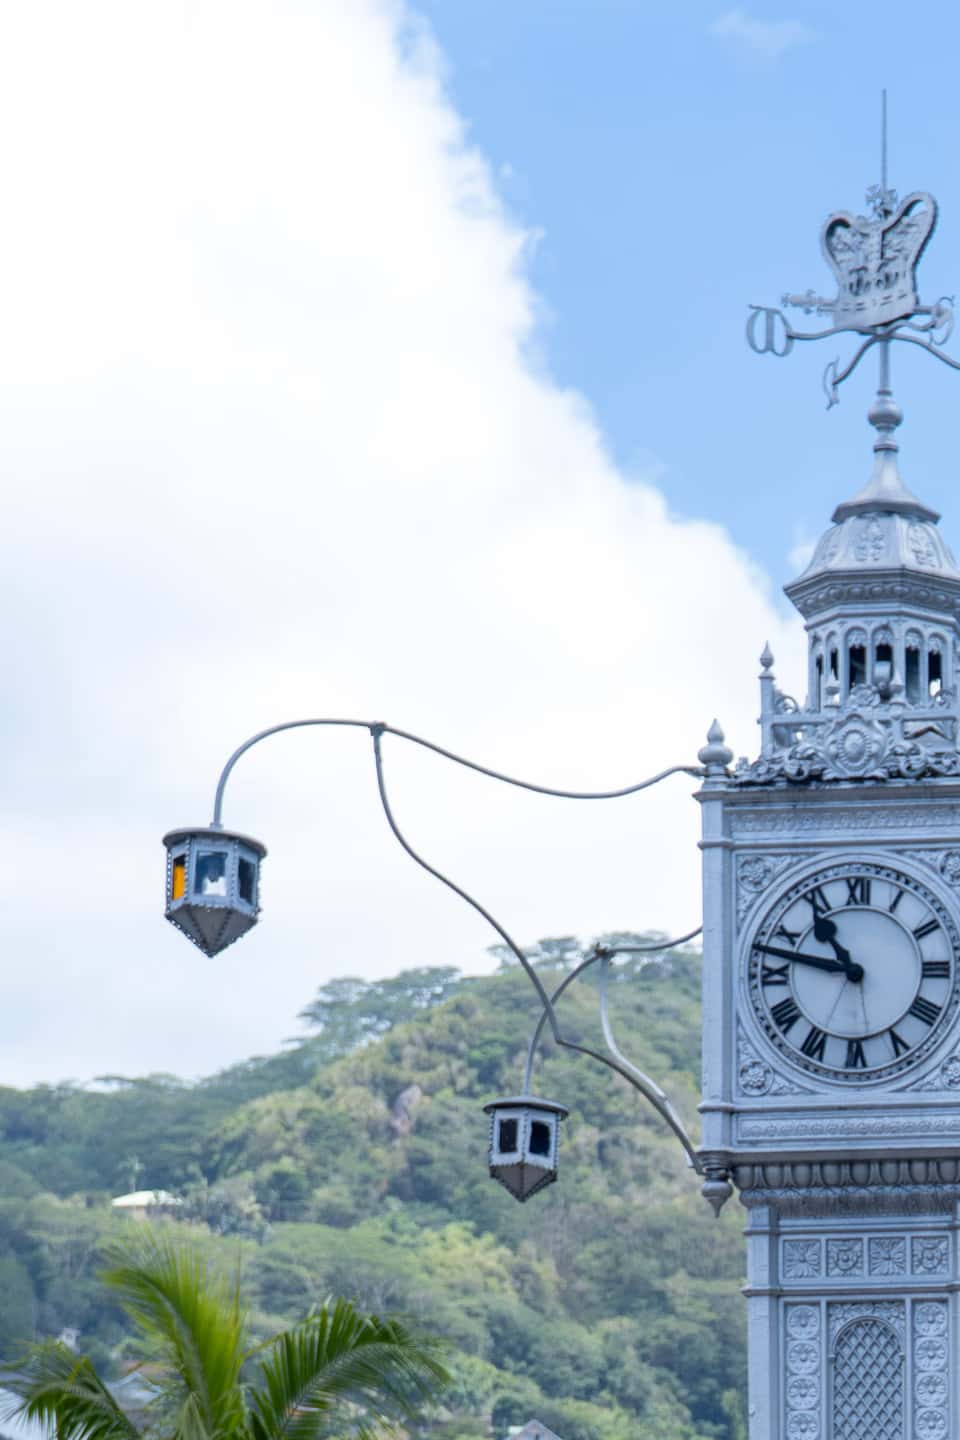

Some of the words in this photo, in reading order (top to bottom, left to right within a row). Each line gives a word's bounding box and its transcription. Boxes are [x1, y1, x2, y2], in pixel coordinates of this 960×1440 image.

[846, 878, 871, 906] XII
[889, 890, 905, 913] I
[775, 924, 801, 947] X
[912, 919, 942, 940] II
[761, 963, 789, 986] IX
[921, 961, 950, 978] III
[844, 1039, 868, 1068] VI
[888, 1027, 912, 1058] V
